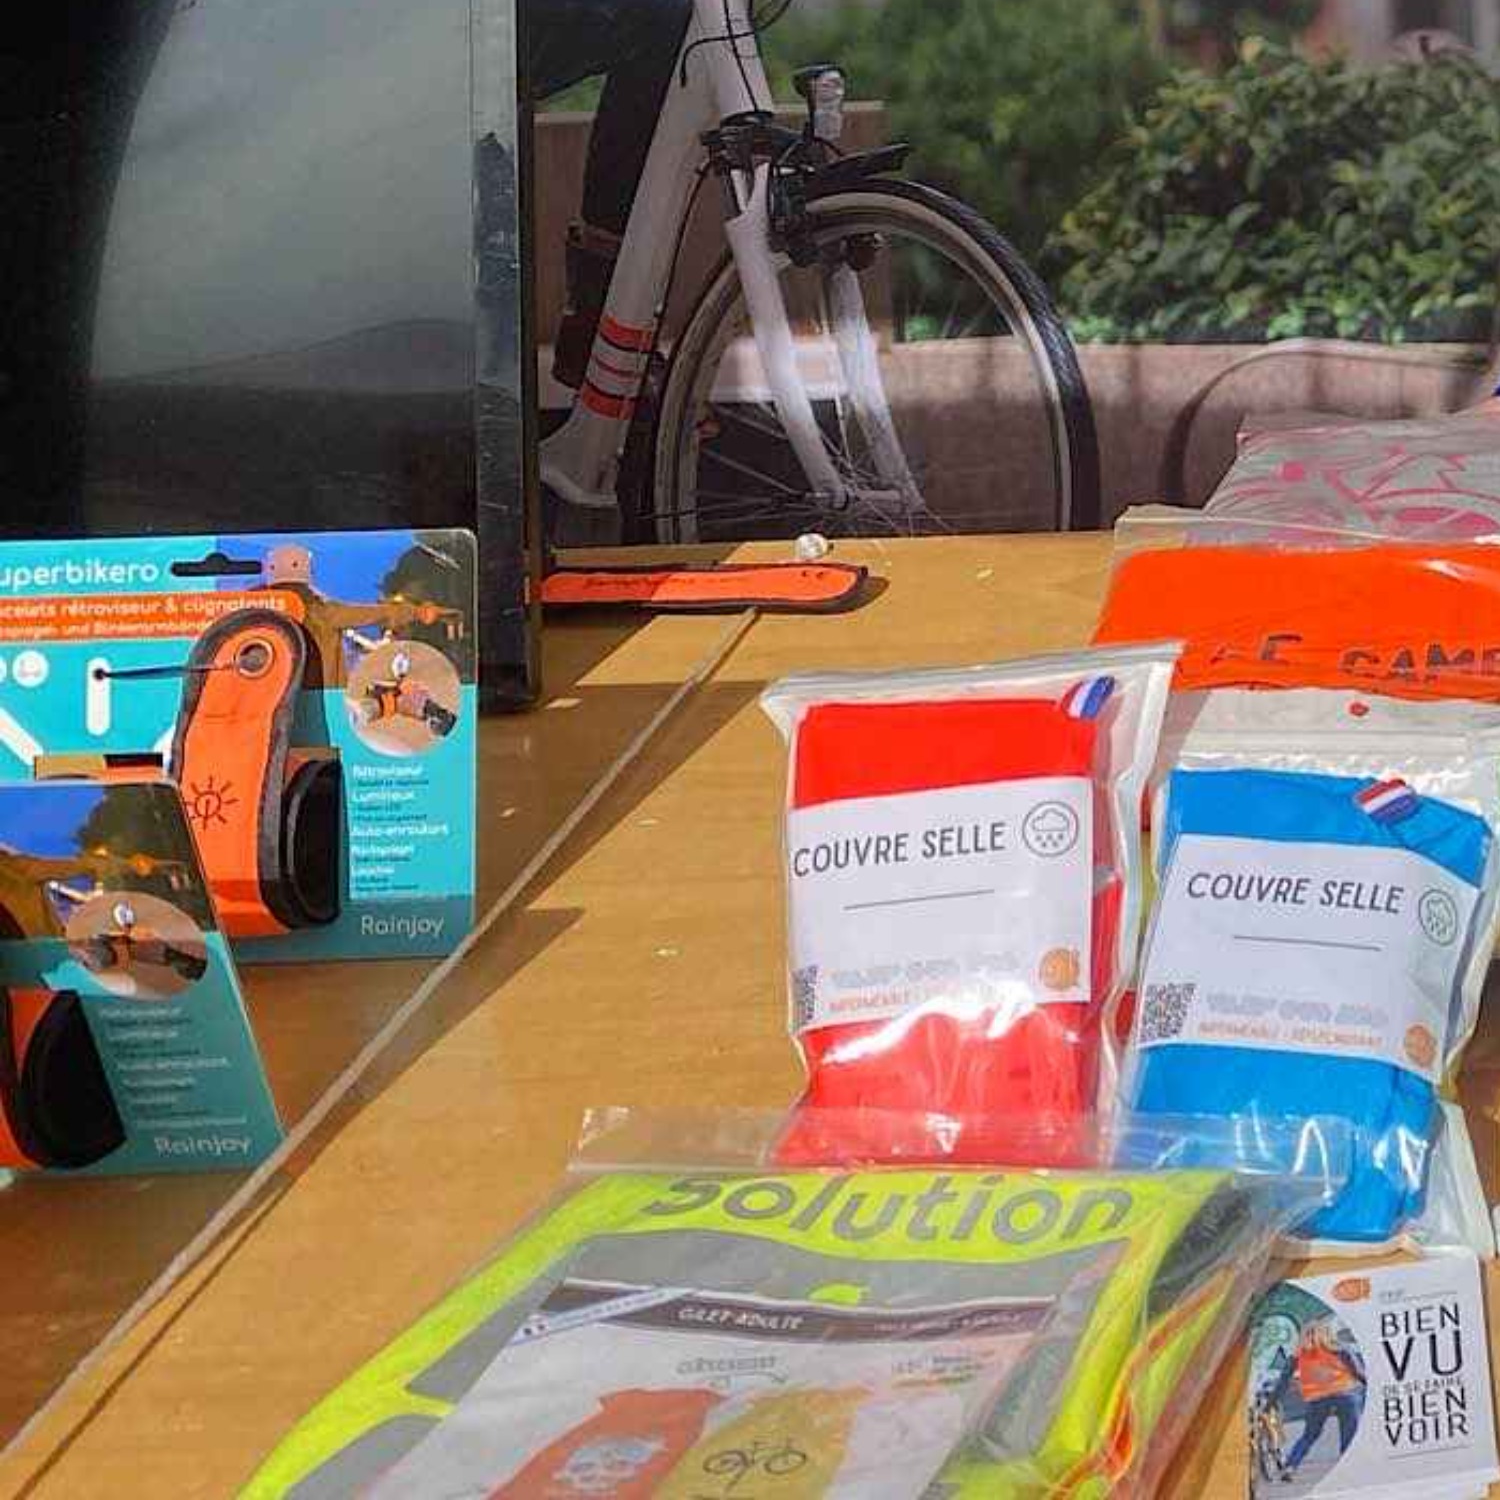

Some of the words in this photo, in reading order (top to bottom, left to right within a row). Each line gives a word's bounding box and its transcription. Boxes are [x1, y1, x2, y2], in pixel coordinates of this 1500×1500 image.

[793, 832, 909, 877] COUVRE
[921, 821, 1006, 859] SELLE
[1187, 871, 1310, 905] COUVRE
[1319, 879, 1404, 914] SELLE
[361, 915, 444, 939] Rainjoy
[1380, 1301, 1461, 1338] BIEN
[1382, 1329, 1463, 1381] VU
[1383, 1385, 1467, 1423] BIEN
[1384, 1412, 1469, 1447] VOIR
